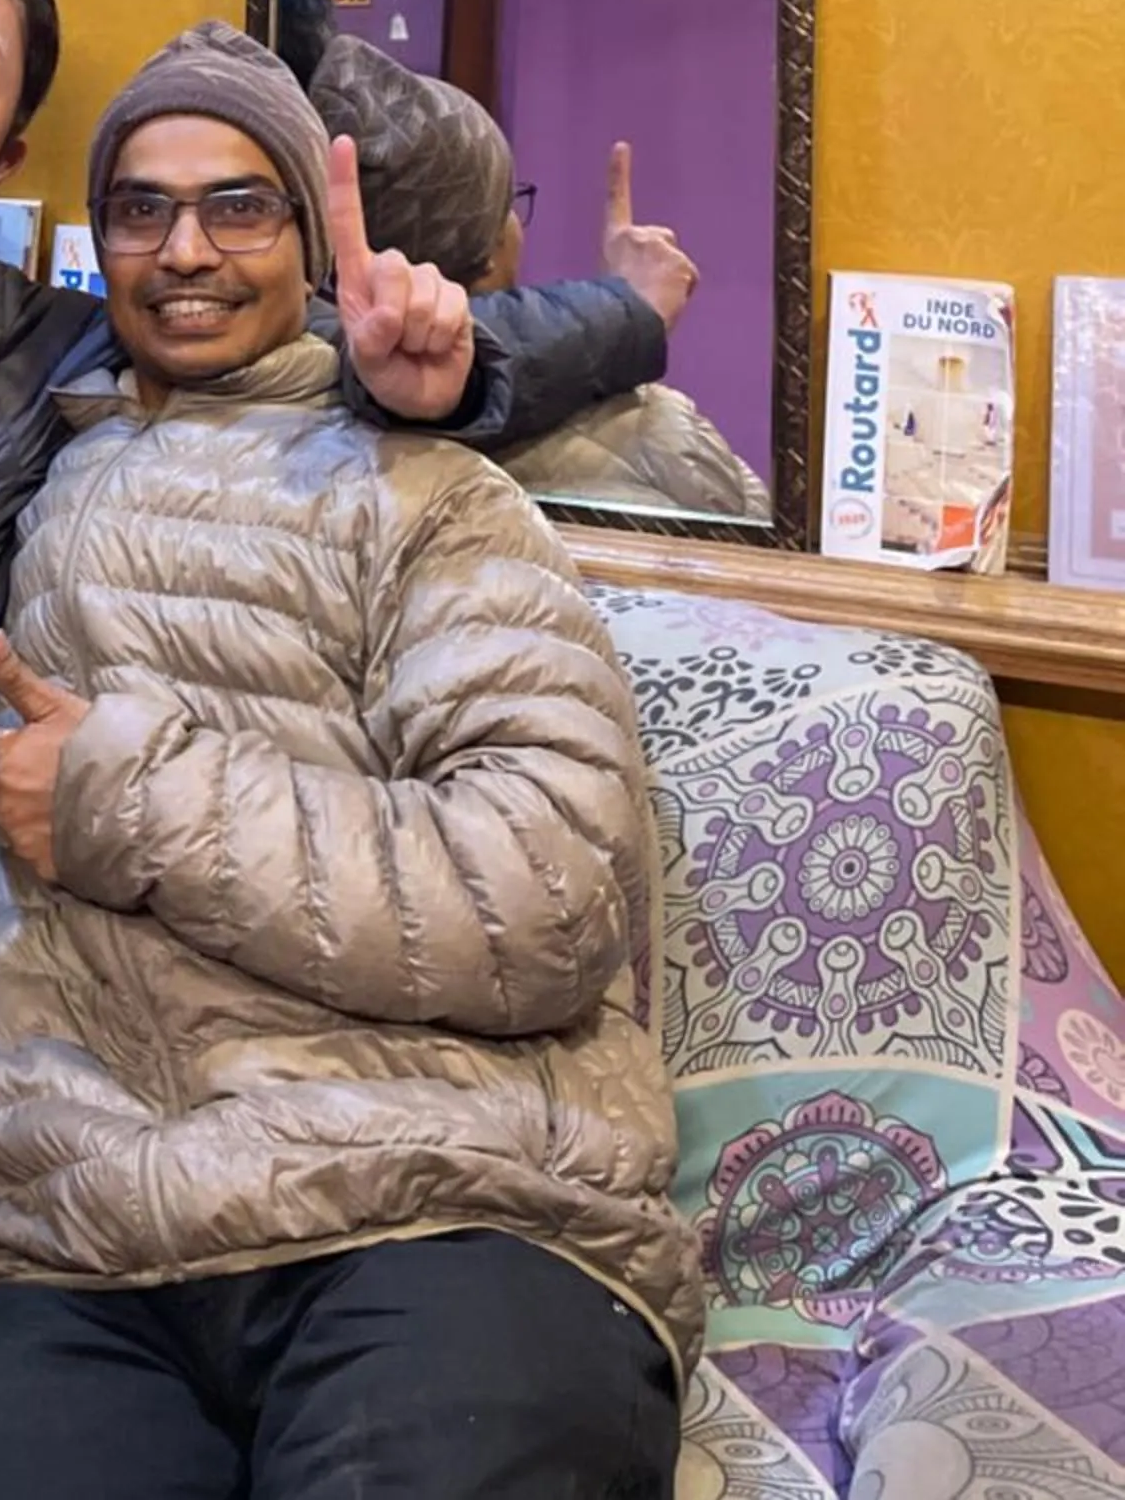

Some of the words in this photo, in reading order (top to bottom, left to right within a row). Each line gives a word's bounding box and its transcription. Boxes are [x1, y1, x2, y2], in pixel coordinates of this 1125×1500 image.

[926, 298, 975, 318] INDE
[903, 312, 932, 331] DU
[937, 318, 996, 339] NORD
[840, 328, 882, 494] Routard
